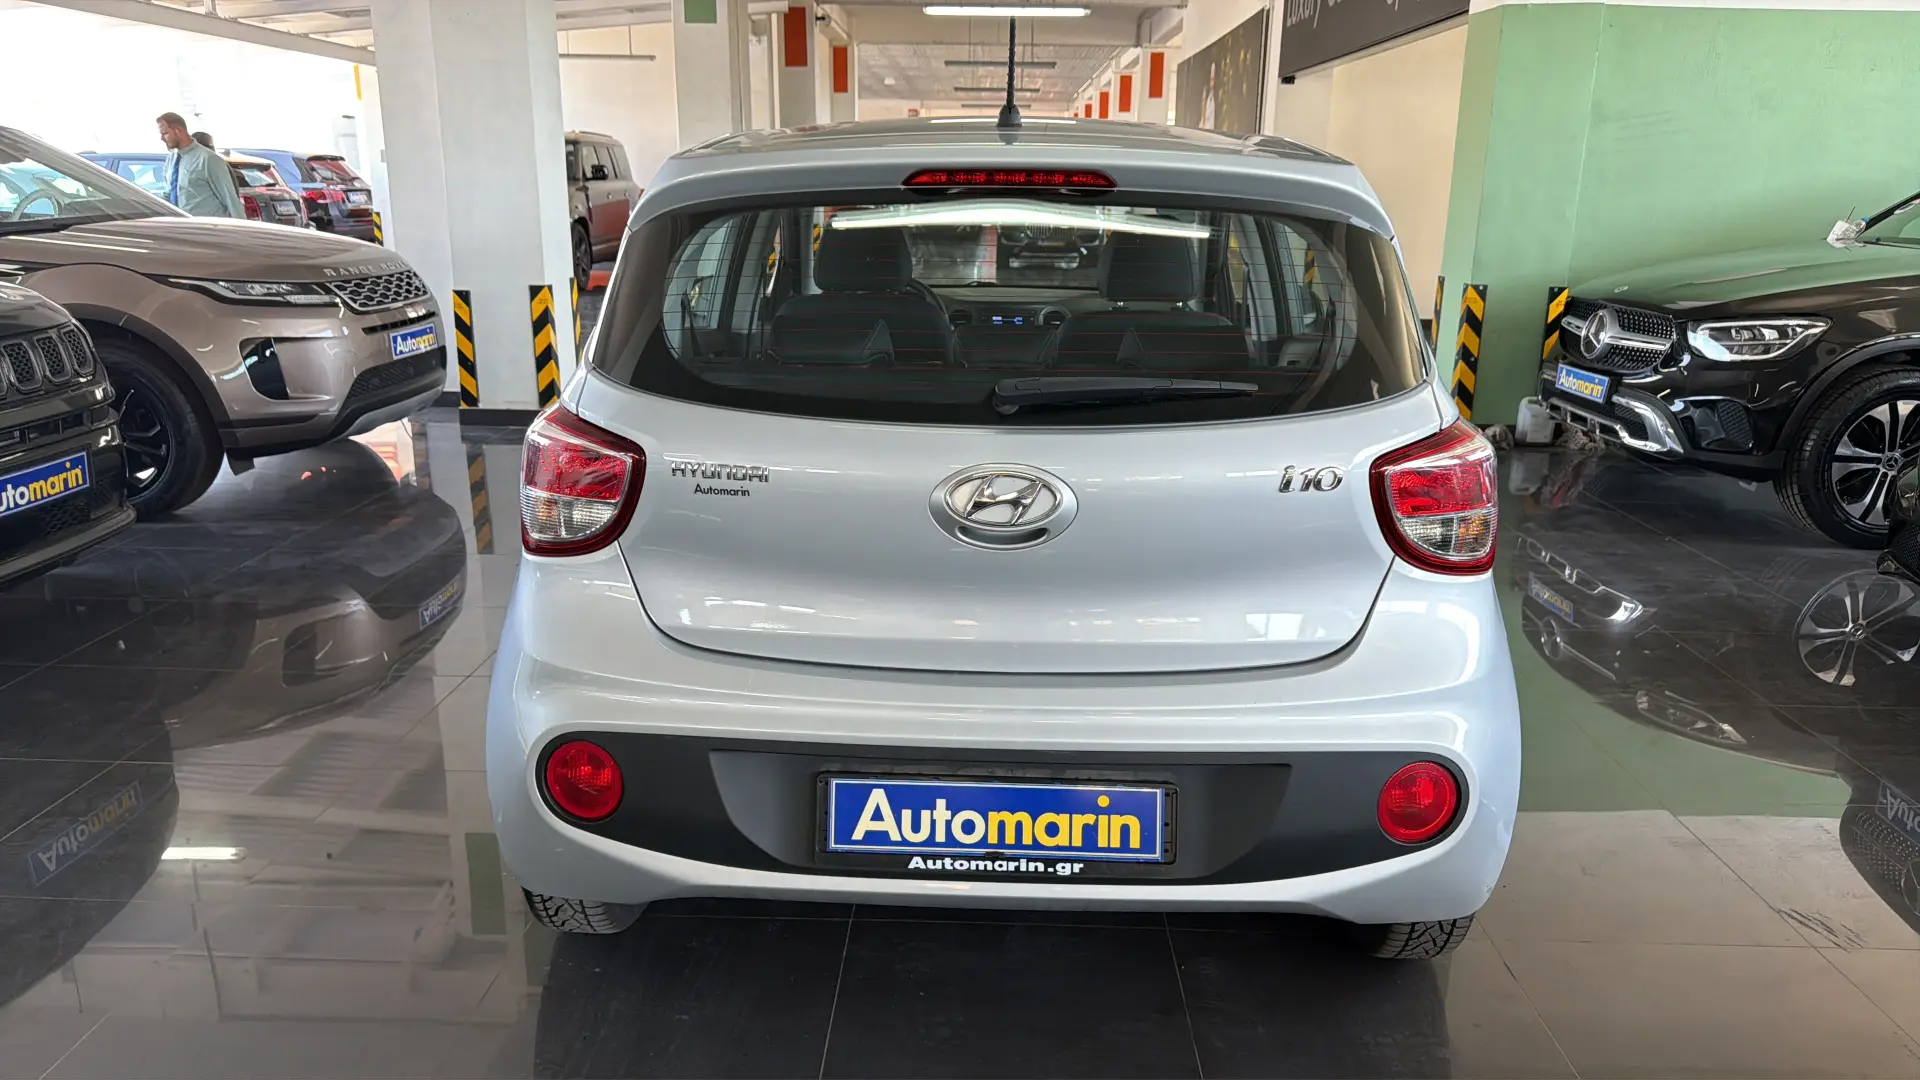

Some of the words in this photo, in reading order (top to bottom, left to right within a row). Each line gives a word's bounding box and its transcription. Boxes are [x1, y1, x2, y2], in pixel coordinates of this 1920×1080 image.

[323, 265, 376, 277] RANGE
[396, 328, 435, 354] Automarin
[1559, 368, 1603, 397] Automarin
[671, 461, 769, 482] HYUNDAI
[1279, 465, 1343, 493] i10
[0, 461, 83, 512] utomarin
[694, 483, 750, 497] Automarin
[851, 788, 1140, 849] Automarin
[908, 856, 1084, 876] Automarin.gr
